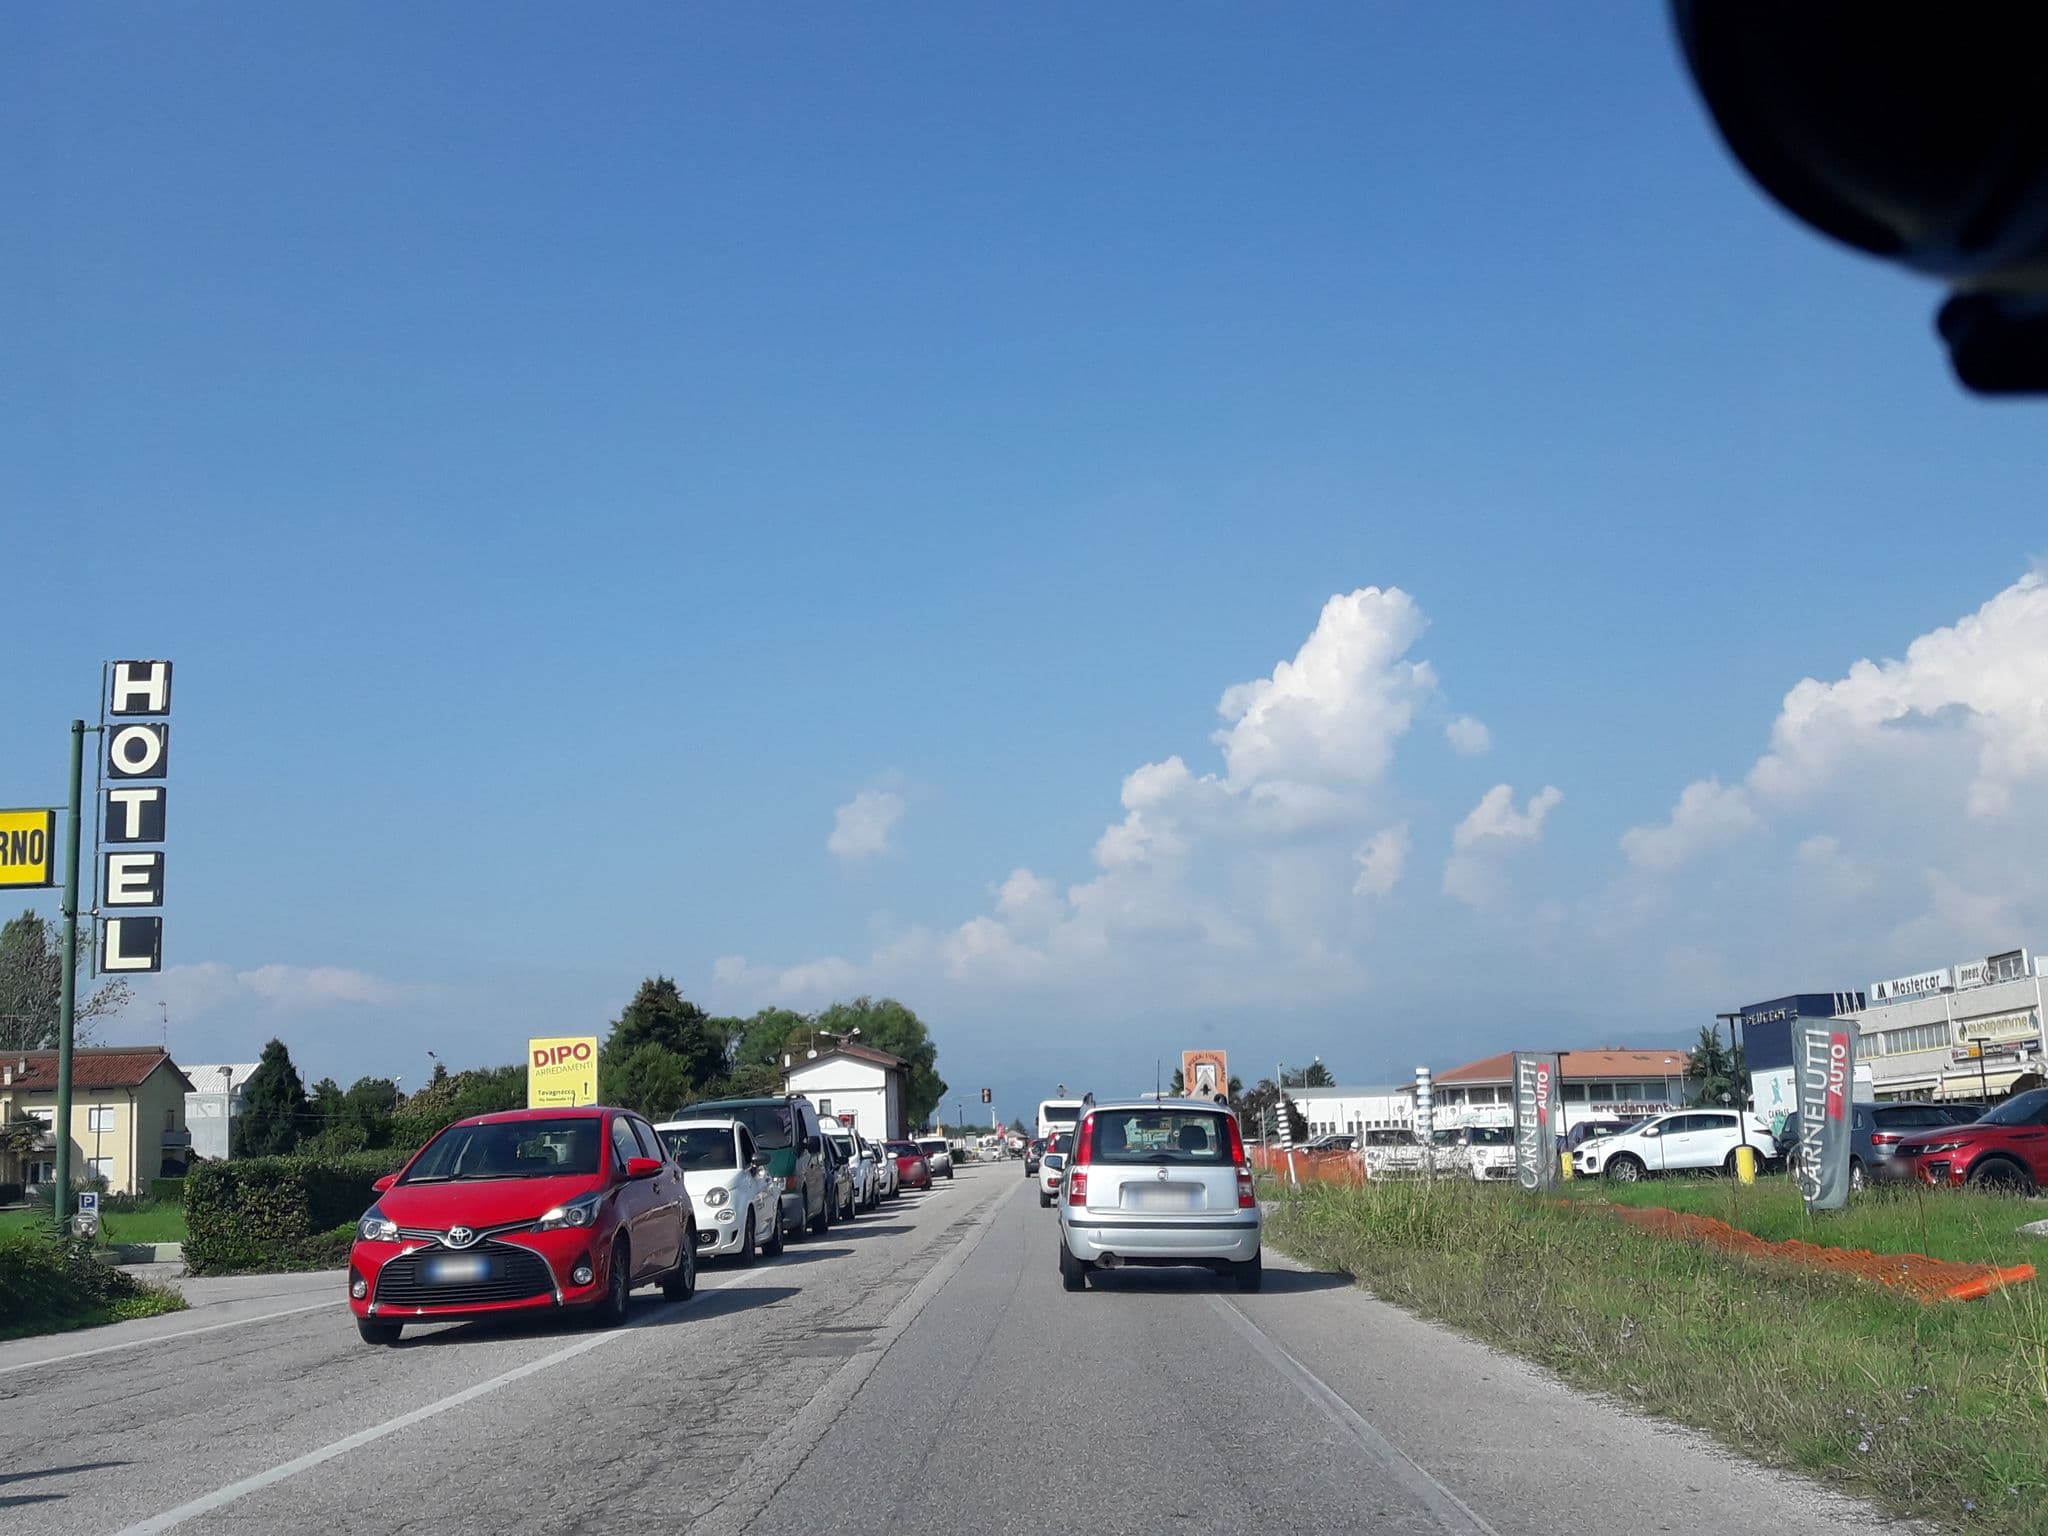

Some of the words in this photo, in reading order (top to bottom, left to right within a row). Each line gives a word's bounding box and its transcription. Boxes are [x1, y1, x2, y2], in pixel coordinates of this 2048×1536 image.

[105, 663, 166, 969] HOTEL
[533, 1043, 591, 1067] DIPO
[535, 1062, 593, 1077] ARREDAMENTI
[1829, 1044, 1846, 1097] AUTO
[1537, 1071, 1549, 1110] AUTO
[1520, 1060, 1539, 1188] CARNELUTTI
[1802, 1029, 1830, 1202] CARNELUTTI
[83, 1196, 93, 1207] P
